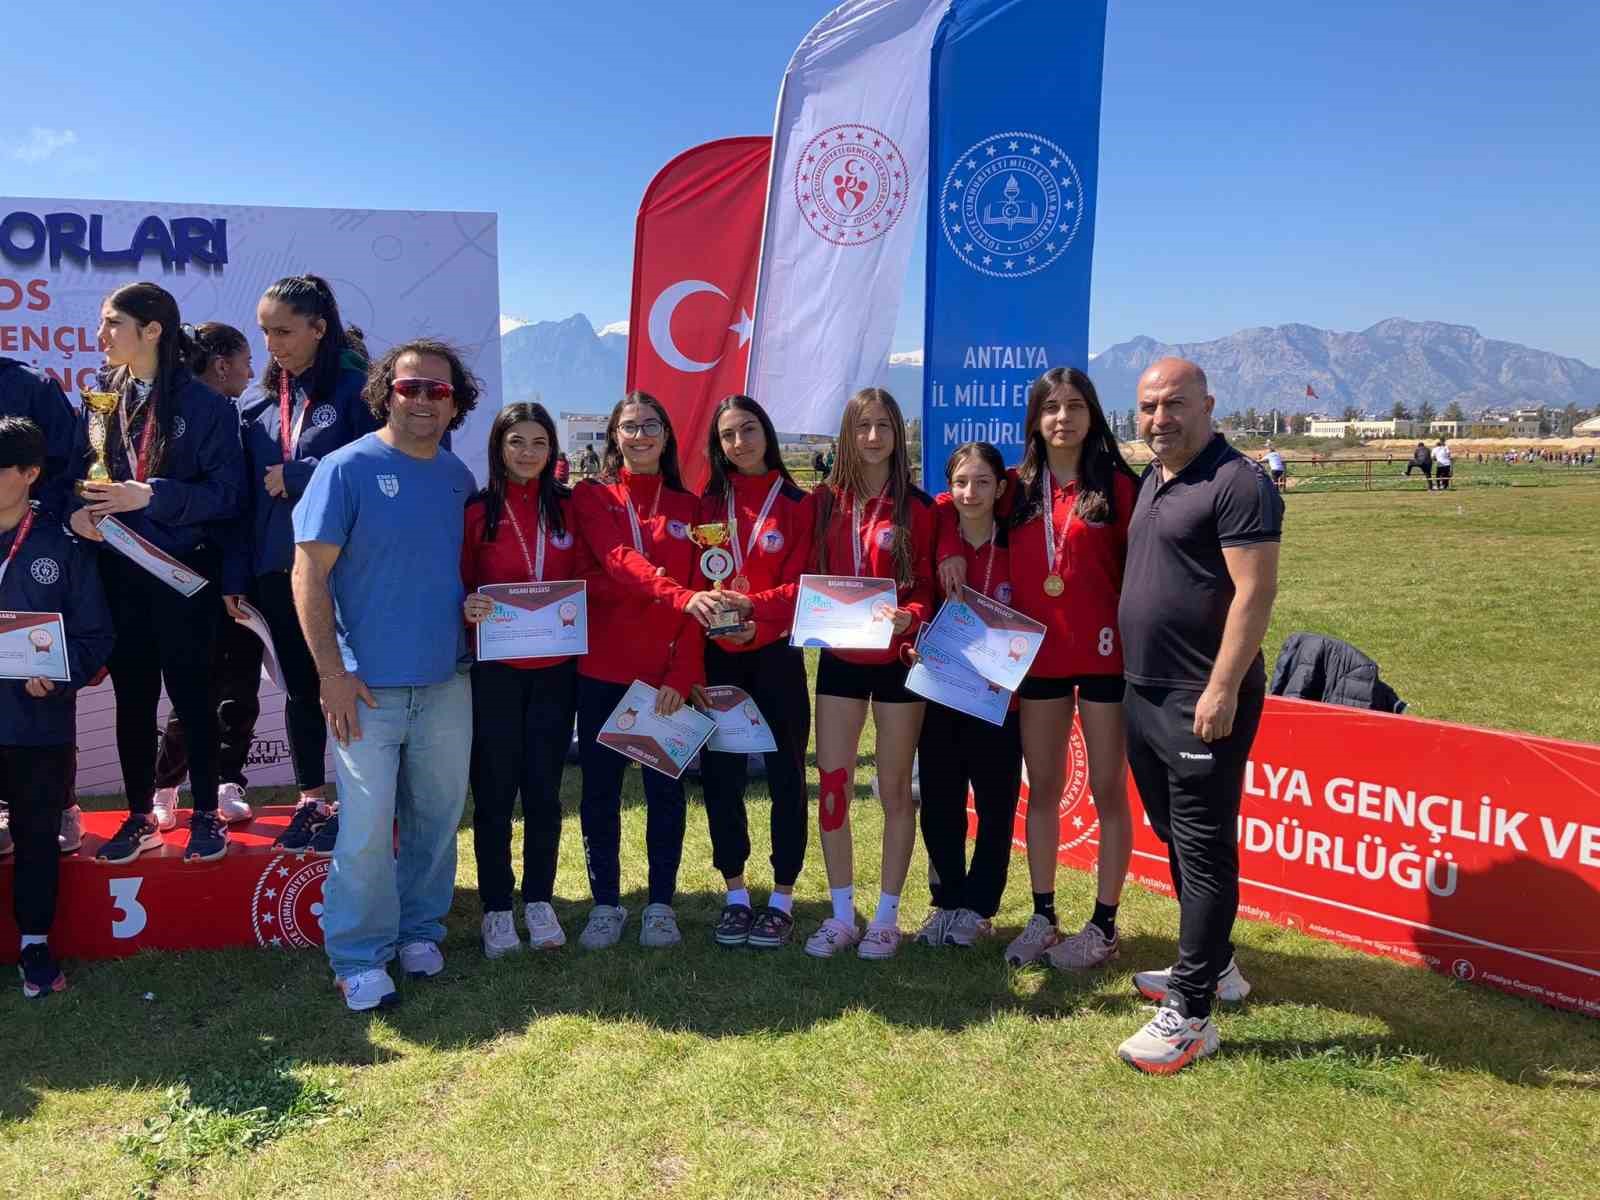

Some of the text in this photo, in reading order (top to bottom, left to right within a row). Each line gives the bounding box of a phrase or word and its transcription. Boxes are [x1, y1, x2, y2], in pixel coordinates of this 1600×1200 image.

[0, 211, 228, 271] ORLARI
[963, 346, 1049, 369] ANTALYA
[932, 380, 949, 407] İL
[955, 380, 1006, 407] MİLLİ
[1098, 627, 1114, 656] 8
[1070, 734, 1085, 767] SPOR
[1244, 761, 1600, 868] LYA GENÇLİK VE
[1237, 814, 1459, 897] DÜRLÜĞÜ
[108, 877, 147, 939] 3
